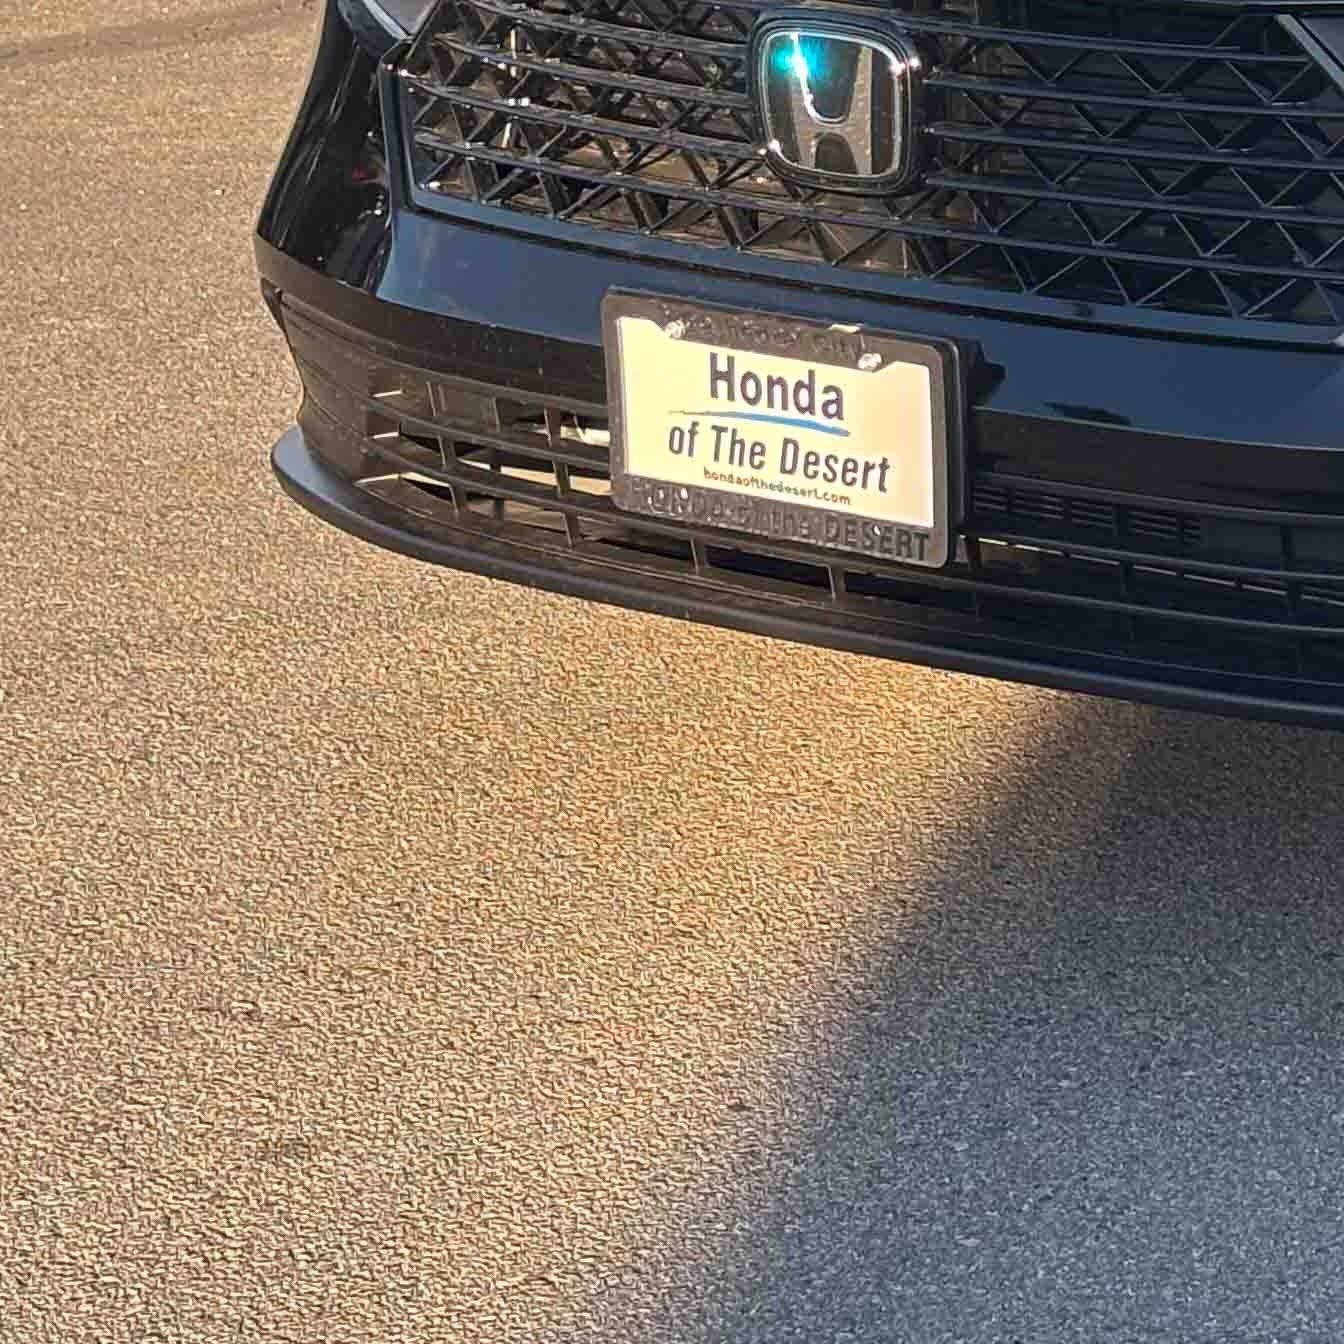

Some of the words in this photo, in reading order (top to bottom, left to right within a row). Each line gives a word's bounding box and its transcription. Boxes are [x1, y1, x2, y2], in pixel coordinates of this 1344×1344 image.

[708, 351, 845, 421] Honda
[668, 421, 700, 459] of
[711, 425, 767, 471] The
[779, 437, 892, 494] Desert
[703, 466, 851, 505] hondaofthedesert.com
[824, 511, 930, 563] DESERT
